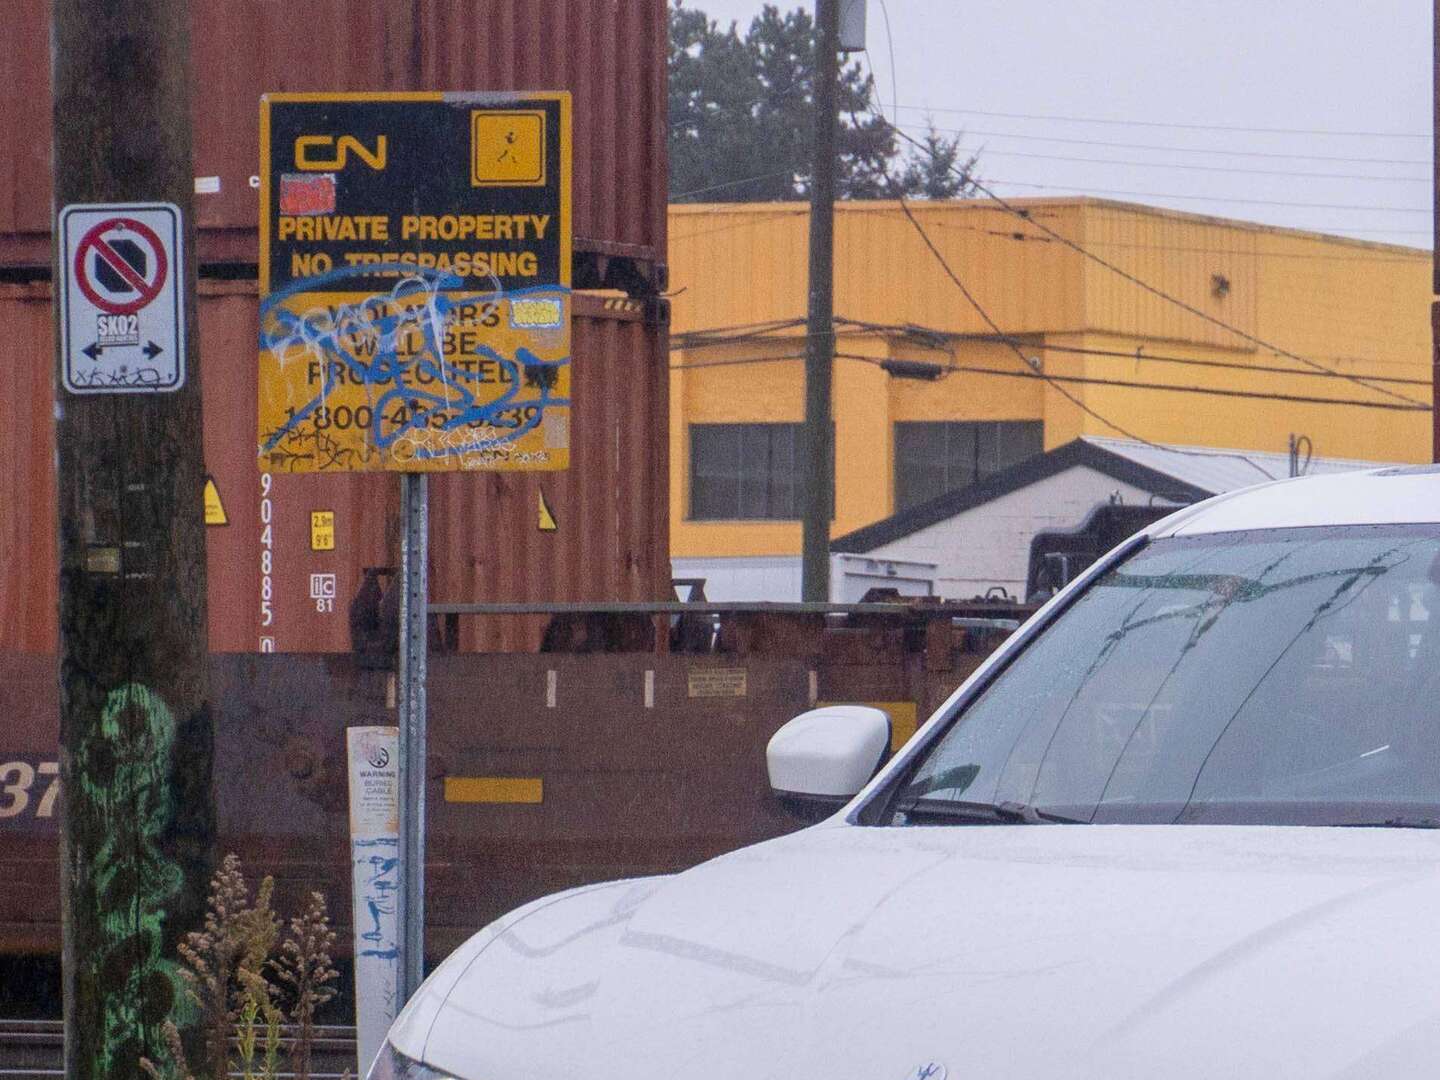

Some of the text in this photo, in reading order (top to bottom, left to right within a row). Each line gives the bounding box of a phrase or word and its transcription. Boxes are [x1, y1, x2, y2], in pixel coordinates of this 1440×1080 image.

[295, 135, 387, 170] CN
[279, 215, 549, 240] PRIVATE PROPERTY
[291, 252, 537, 278] NO TRESPASSING
[316, 599, 332, 612] 81
